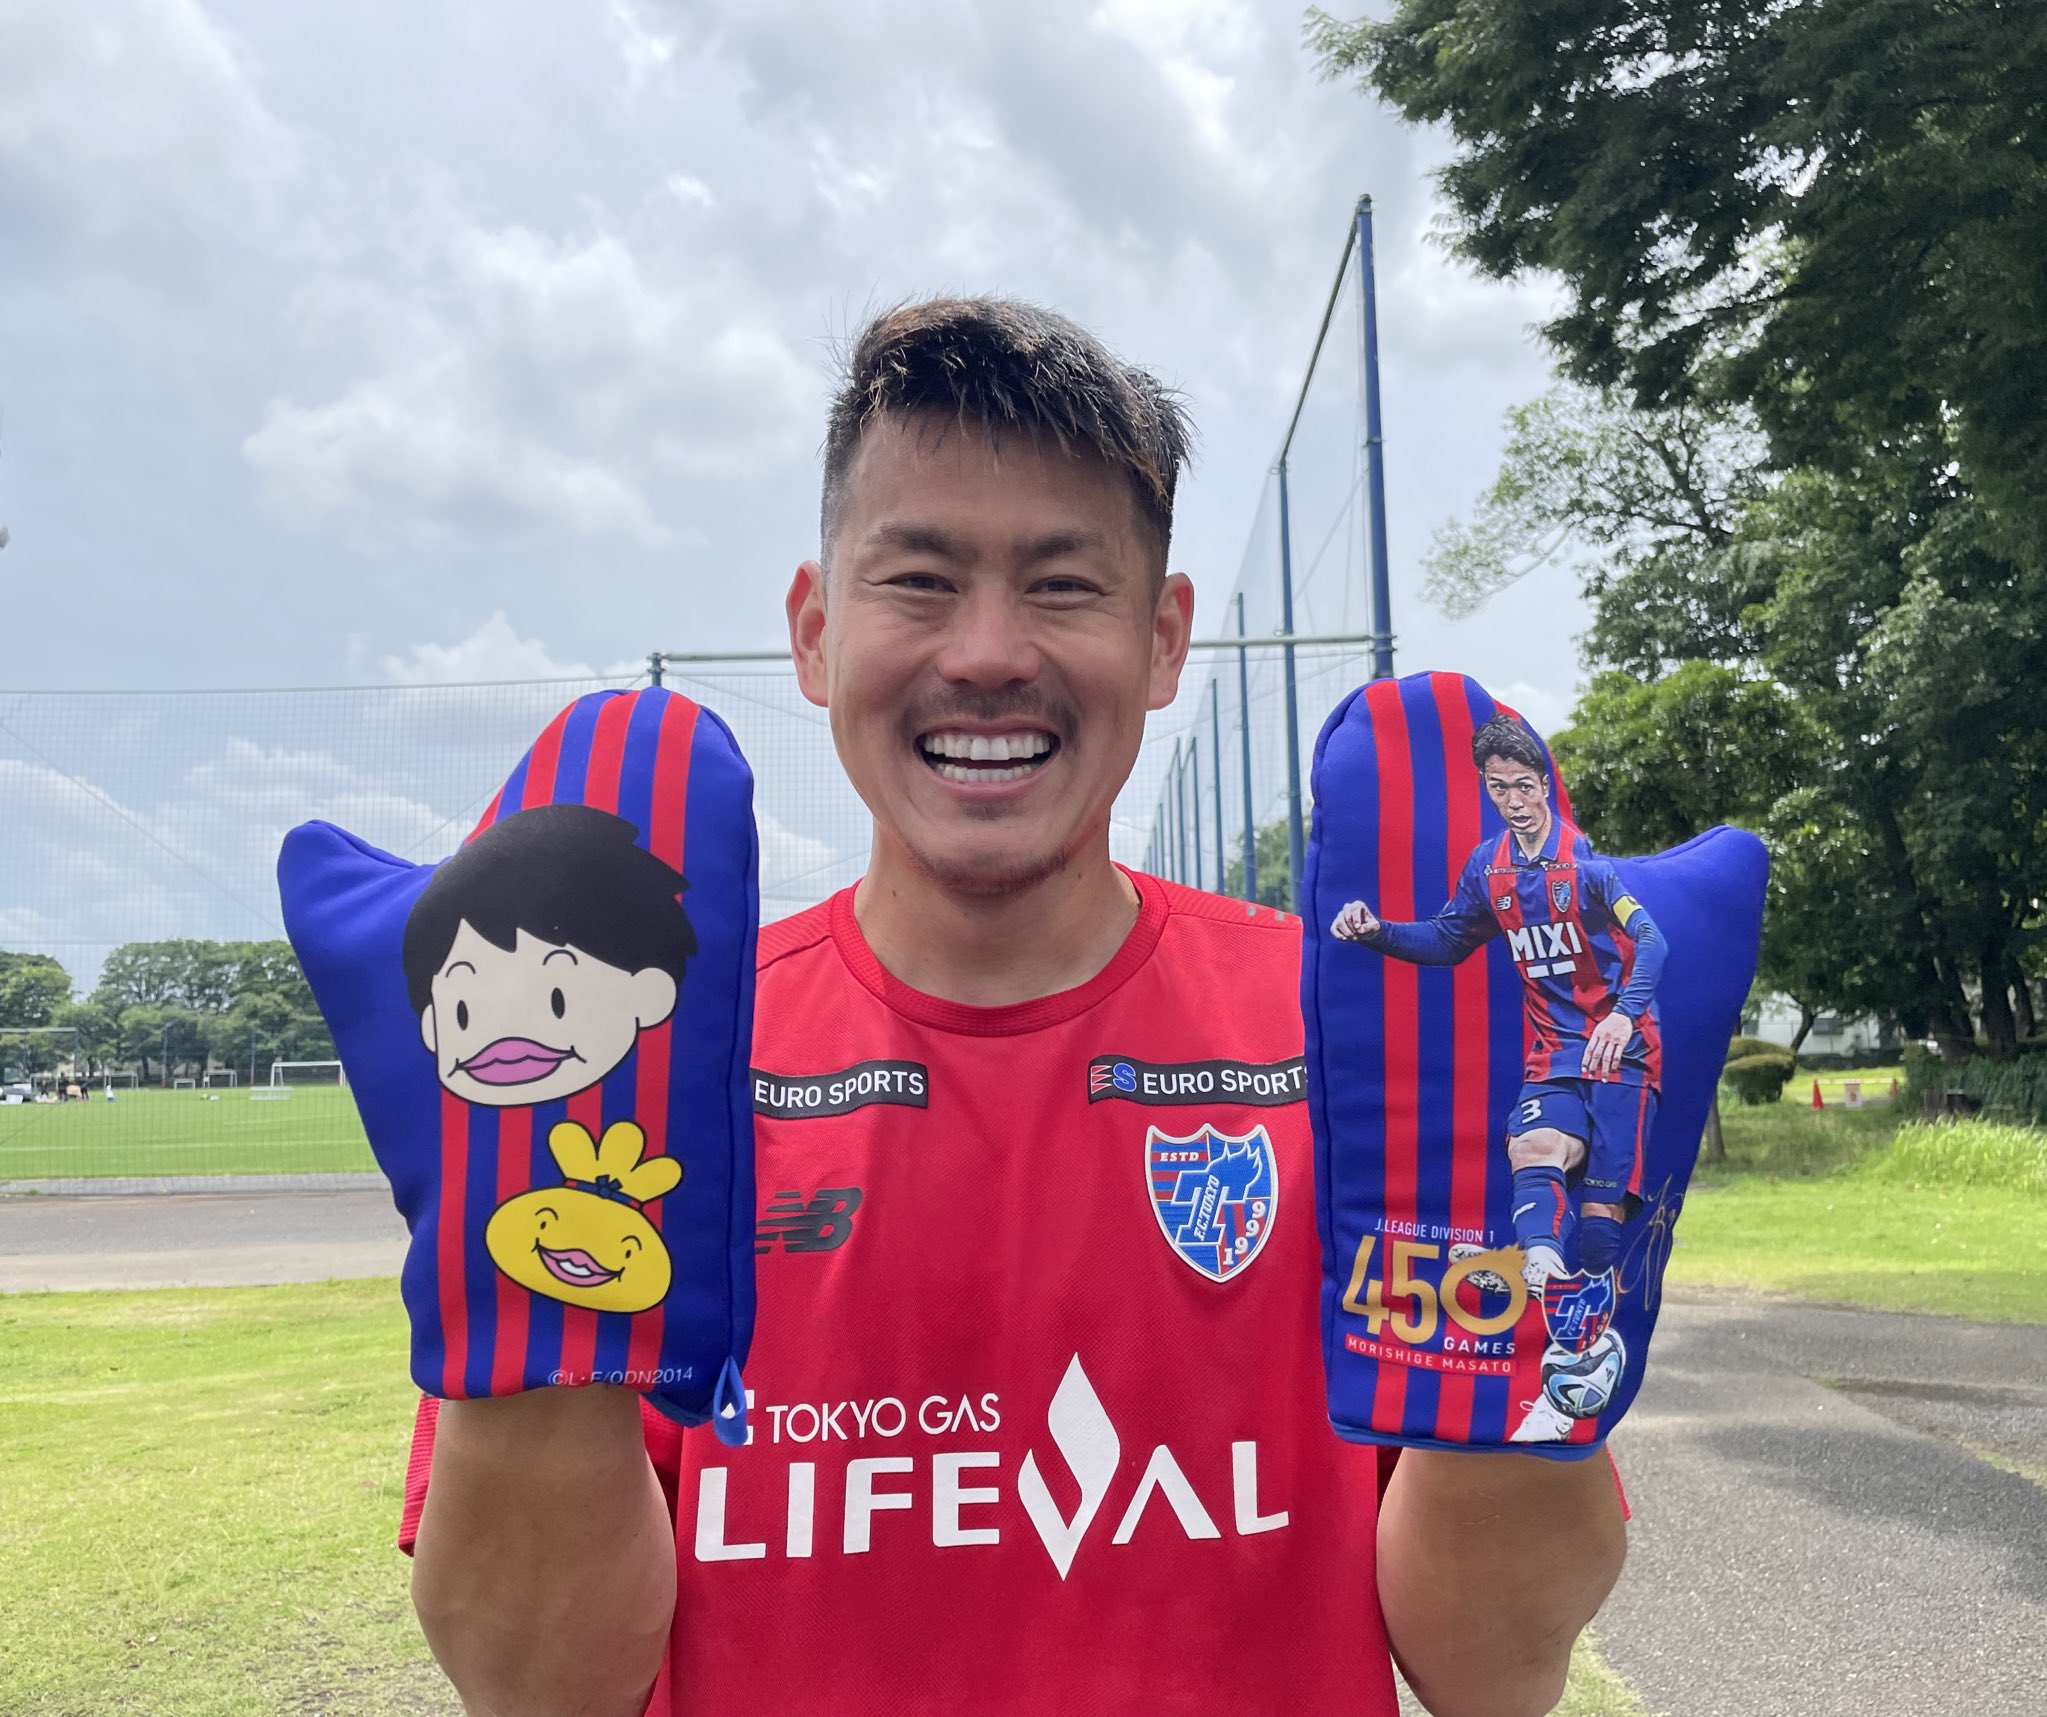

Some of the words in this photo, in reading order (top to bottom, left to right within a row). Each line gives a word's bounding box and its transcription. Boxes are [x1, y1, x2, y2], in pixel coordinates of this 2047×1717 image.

[1507, 921, 1582, 962] MIXI
[755, 1079, 822, 1108] EURO
[828, 1070, 924, 1105] SPORTS
[1143, 1071, 1215, 1095] EURO
[1220, 1065, 1308, 1096] SPORT
[1520, 1098, 1542, 1124] 3
[1160, 1152, 1200, 1162] ESTD
[1375, 1218, 1427, 1238] J.LEAGUE
[1431, 1225, 1484, 1243] DIVISION
[1489, 1230, 1495, 1243] 1
[1343, 1235, 1529, 1344] 450
[1348, 1337, 1433, 1367] MORISHIGE
[1442, 1357, 1512, 1373] MASATO
[1443, 1336, 1517, 1355] GAMES
[766, 1397, 906, 1443] TOKYO
[918, 1393, 1000, 1435] GAS
[695, 1352, 1290, 1581] LIFEVAL
